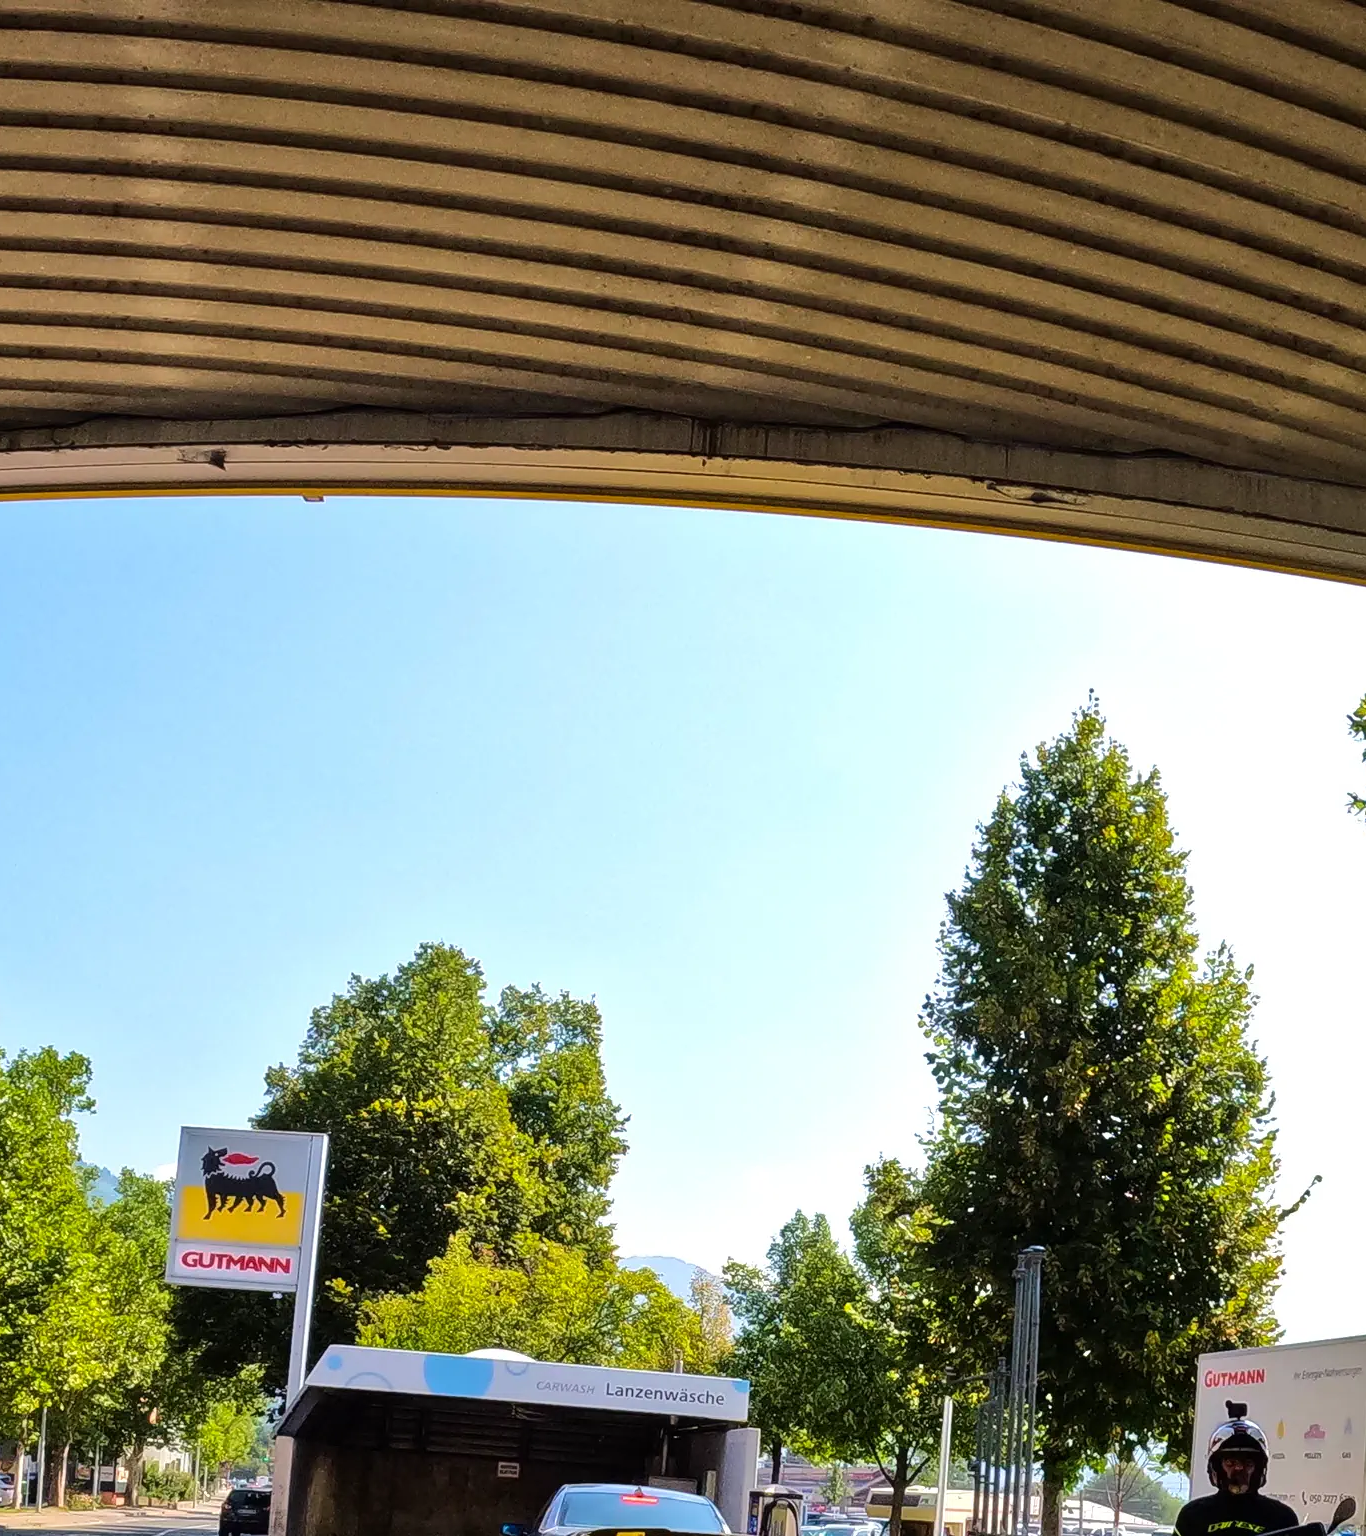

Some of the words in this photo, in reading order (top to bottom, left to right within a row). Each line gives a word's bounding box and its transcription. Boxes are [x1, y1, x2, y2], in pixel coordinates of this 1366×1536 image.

[181, 1251, 291, 1274] GUTMANN
[1204, 1368, 1265, 1388] GUTMANN
[536, 1381, 595, 1395] CARWASH
[605, 1383, 725, 1405] Lanzenwäsche
